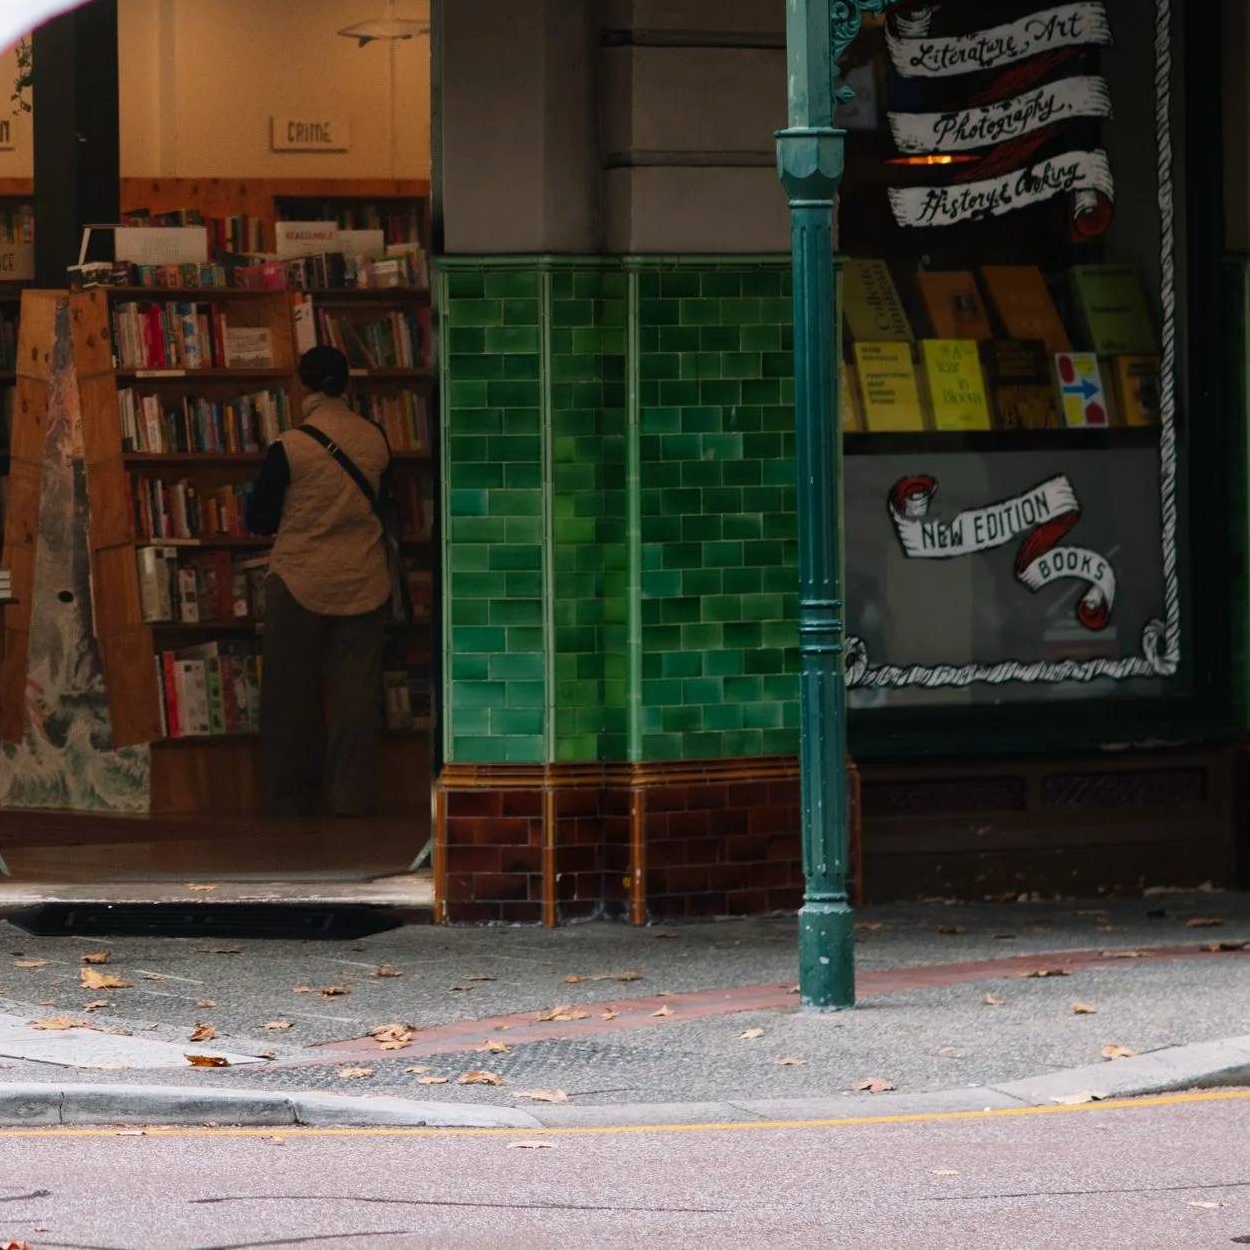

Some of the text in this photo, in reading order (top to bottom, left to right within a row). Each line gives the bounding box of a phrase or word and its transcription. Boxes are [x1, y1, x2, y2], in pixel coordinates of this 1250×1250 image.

[1024, 12, 1083, 41] Art
[287, 121, 333, 143] CRIME
[915, 187, 997, 223] History
[921, 491, 1050, 549] NEW EDITION
[1039, 551, 1106, 580] BOOKS
